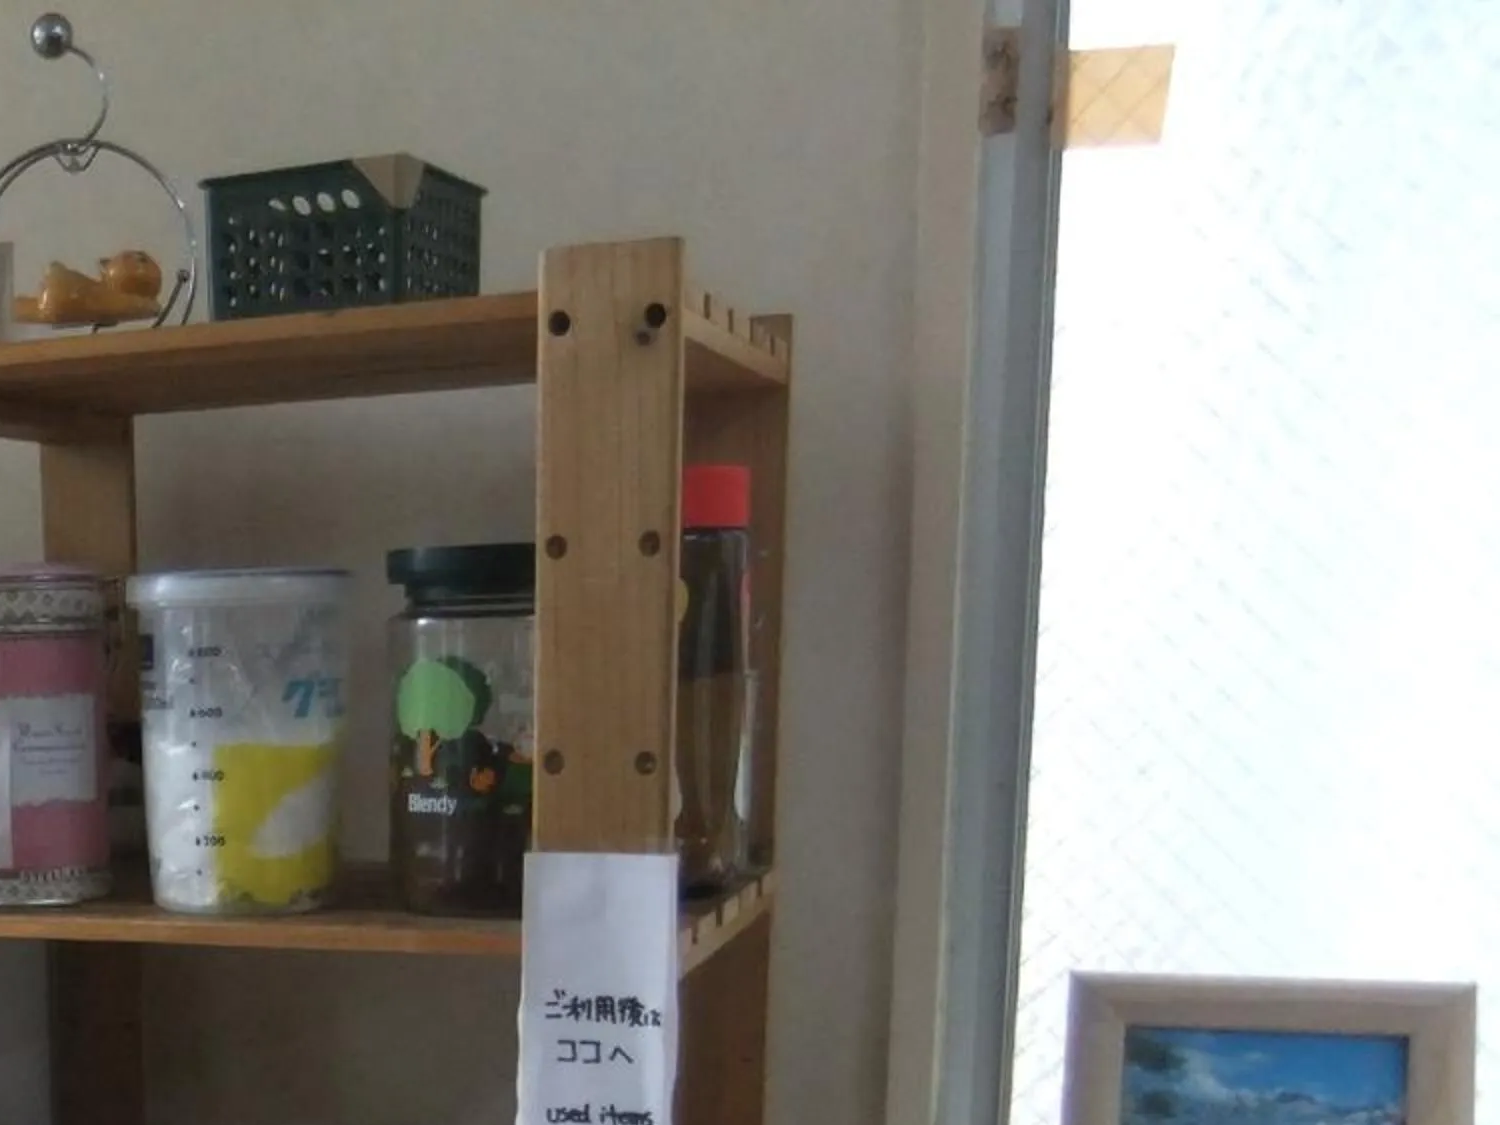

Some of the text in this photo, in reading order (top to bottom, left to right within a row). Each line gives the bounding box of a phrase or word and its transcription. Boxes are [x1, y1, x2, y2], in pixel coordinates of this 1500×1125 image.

[407, 793, 457, 816] Blendy
[545, 988, 662, 1027] ご利用後は
[556, 1038, 635, 1065] ココへ
[546, 1103, 592, 1124] used
